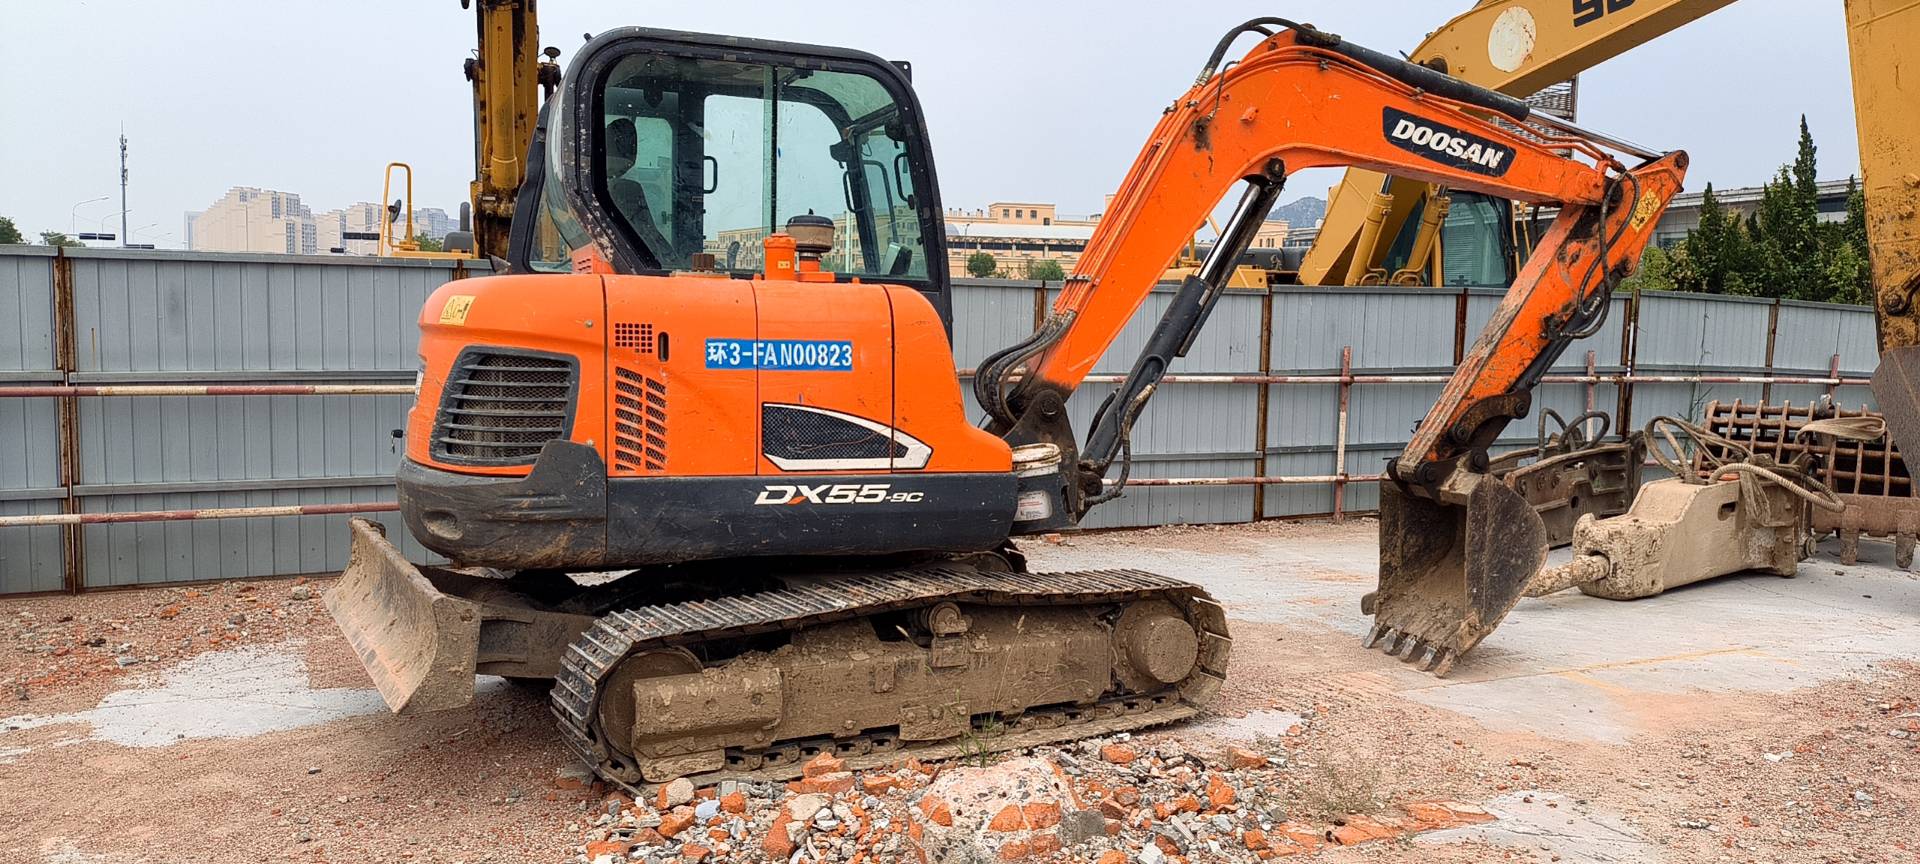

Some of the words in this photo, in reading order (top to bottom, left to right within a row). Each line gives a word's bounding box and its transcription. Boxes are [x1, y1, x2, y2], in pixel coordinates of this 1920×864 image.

[1391, 118, 1504, 169] DOOSAN
[707, 342, 853, 367] 环3-FAN00823
[754, 484, 925, 505] DX55-9C
